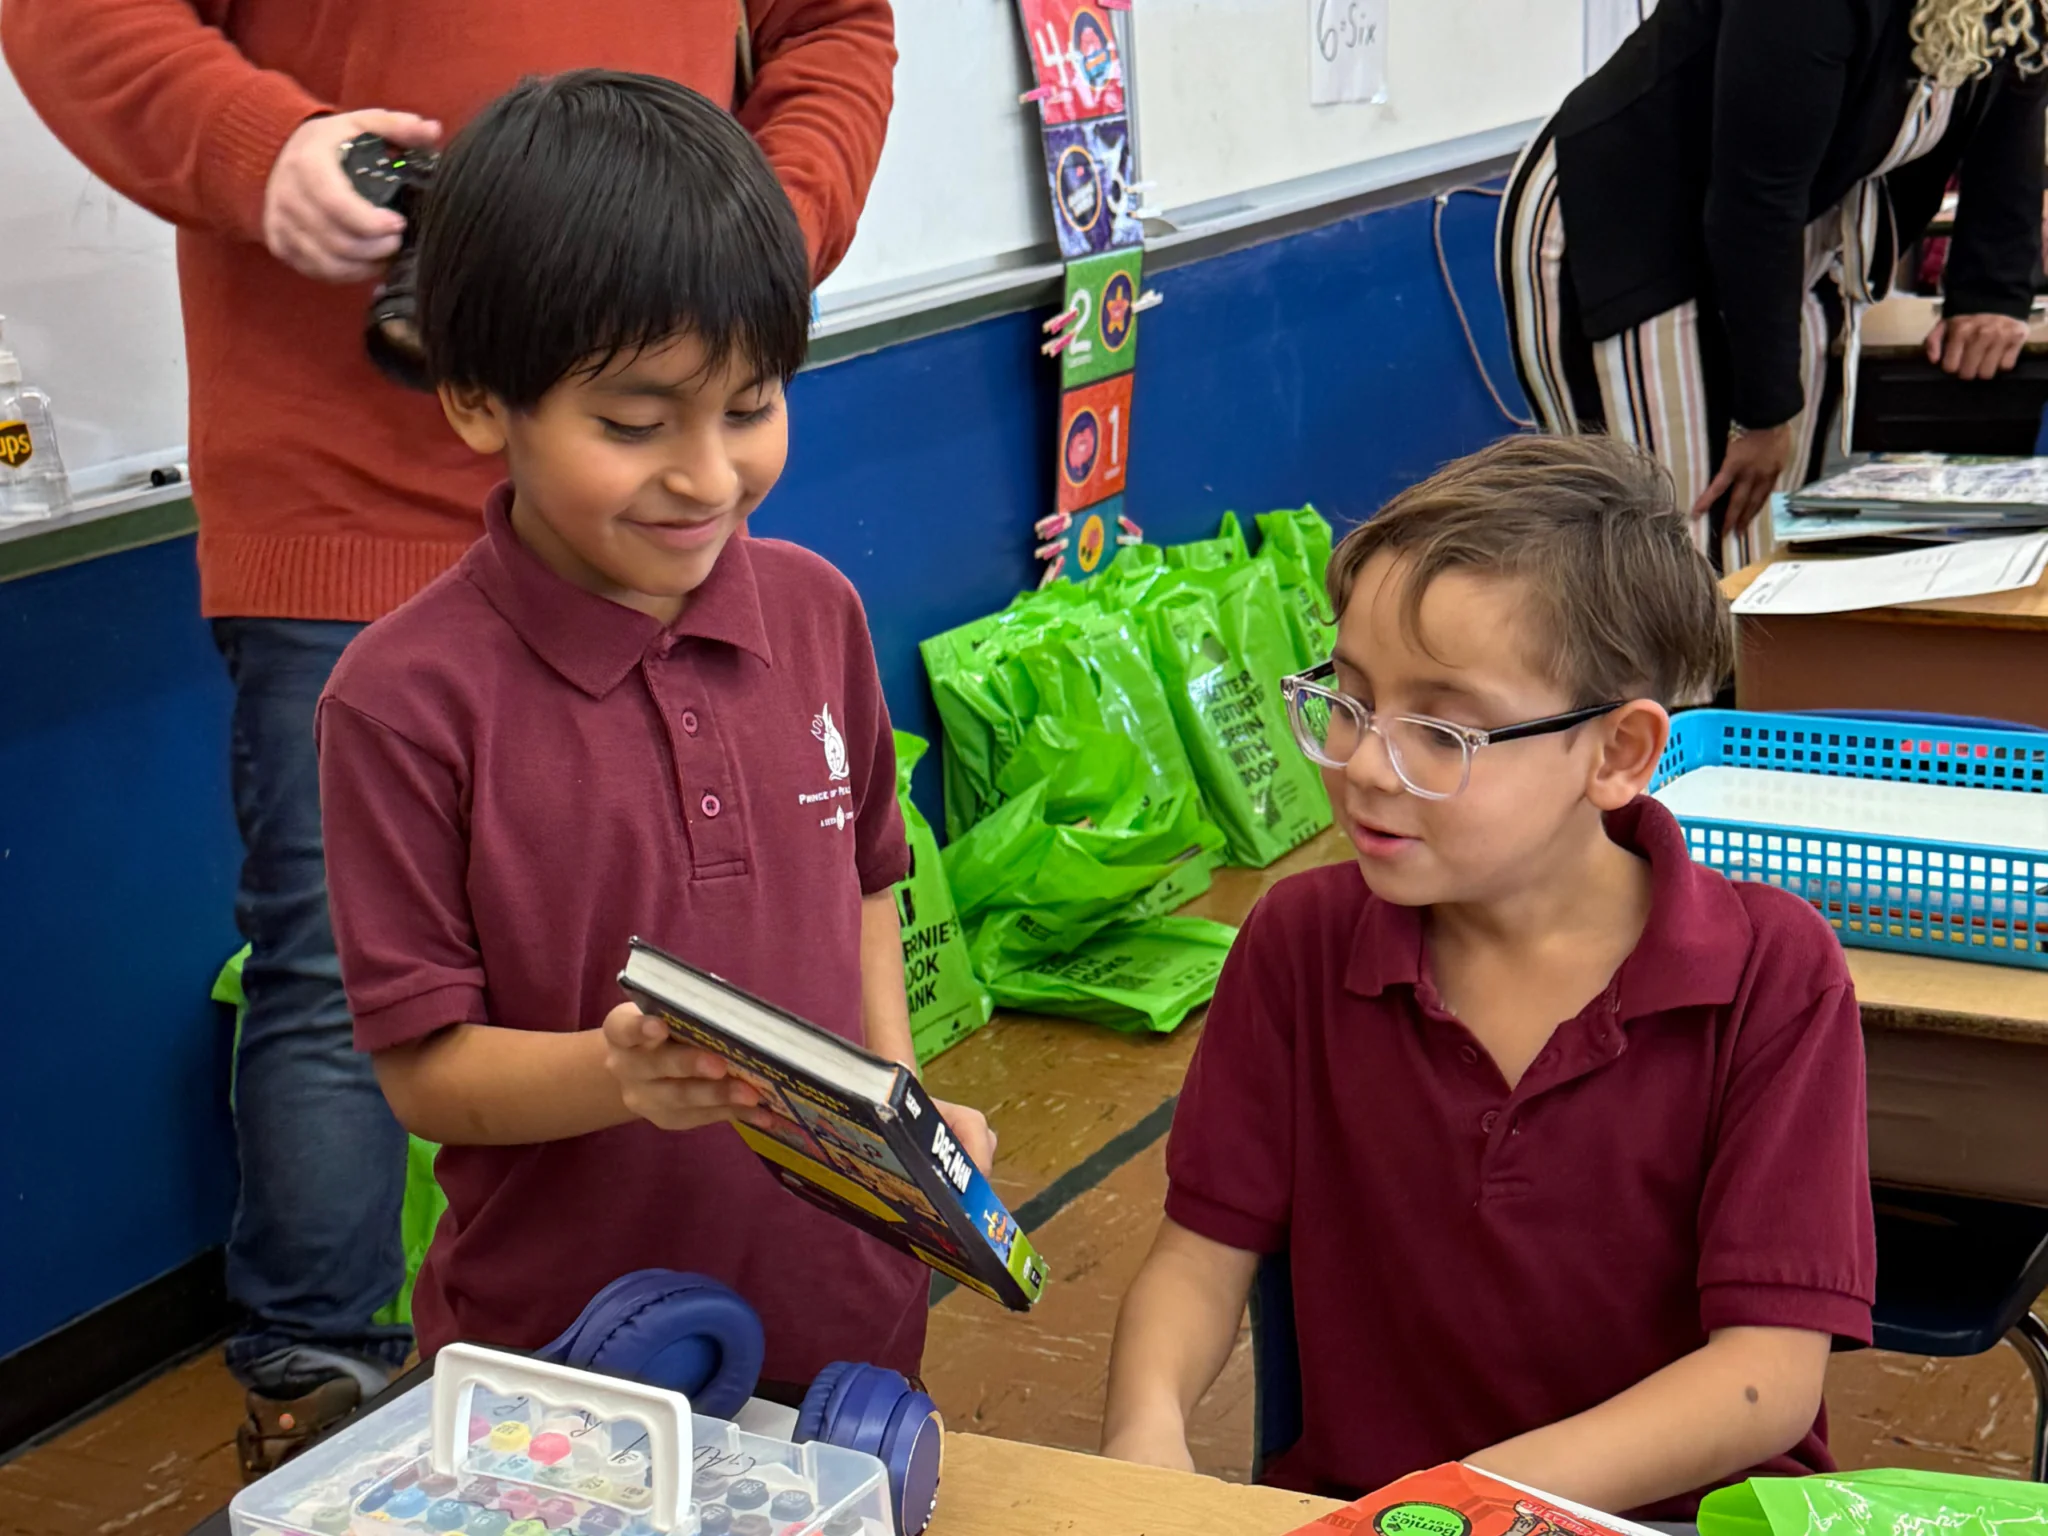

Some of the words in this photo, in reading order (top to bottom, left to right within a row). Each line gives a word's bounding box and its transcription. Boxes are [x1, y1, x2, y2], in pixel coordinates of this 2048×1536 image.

[1069, 288, 1092, 355] 2
[1109, 404, 1120, 465] 1
[907, 952, 940, 987] OOK
[908, 981, 938, 1015] ANK
